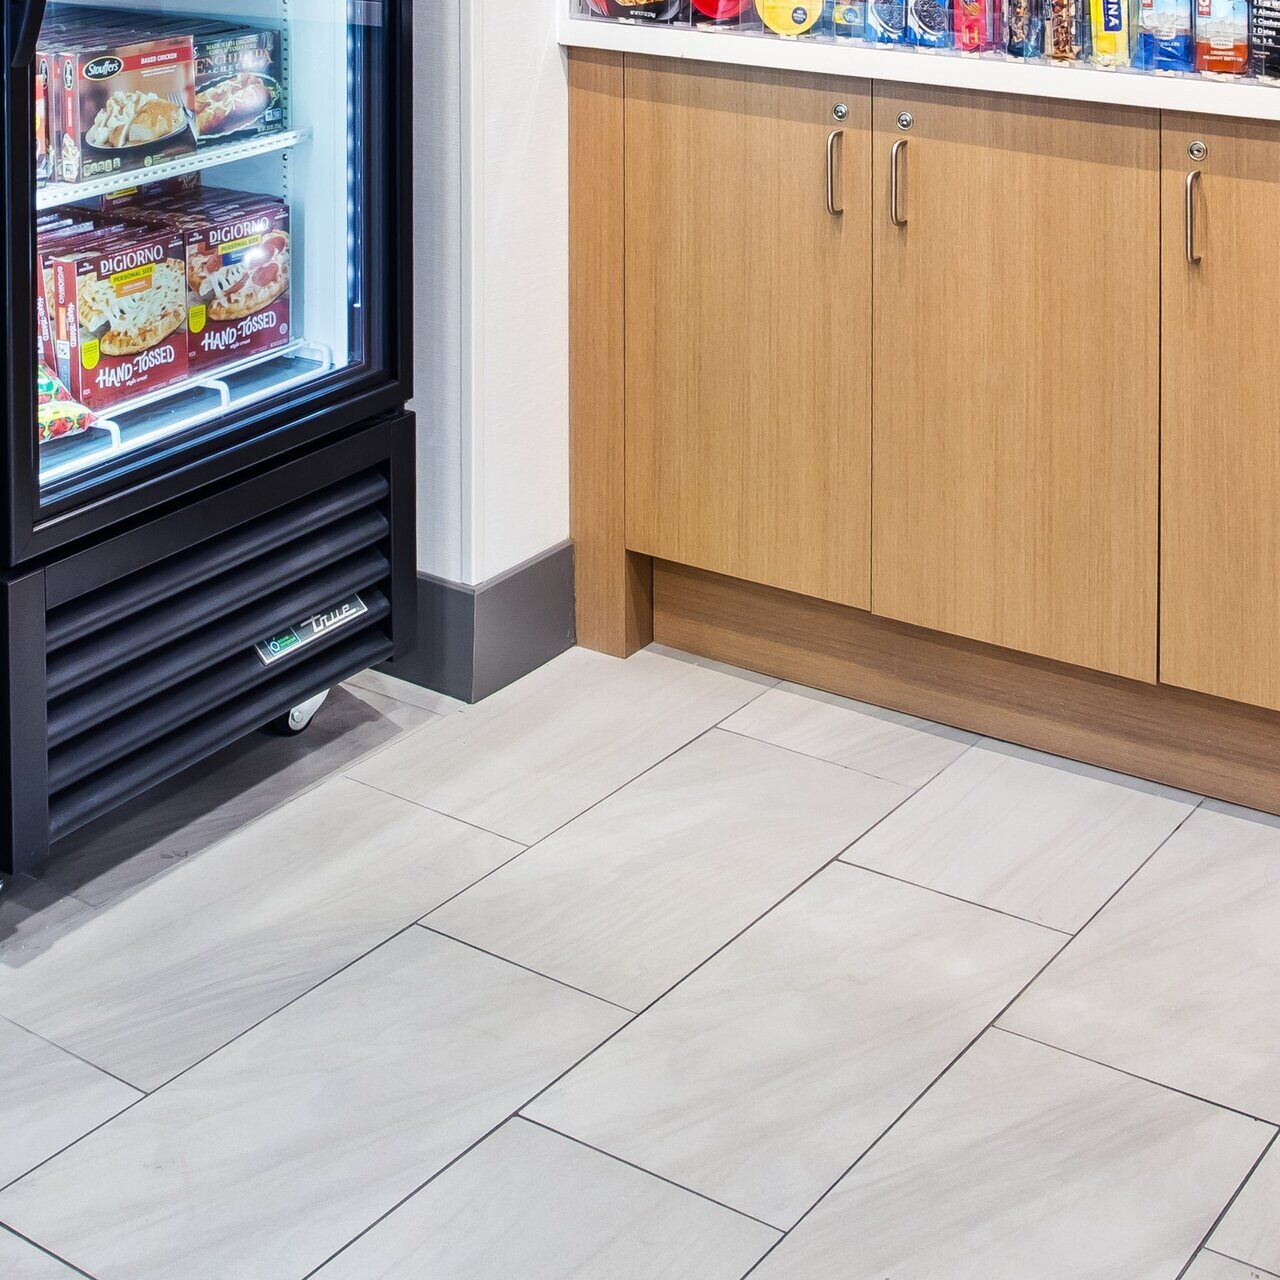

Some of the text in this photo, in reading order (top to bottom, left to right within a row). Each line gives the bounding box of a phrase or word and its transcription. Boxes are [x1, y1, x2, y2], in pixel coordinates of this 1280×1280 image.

[86, 60, 120, 78] Stouffer's
[220, 239, 247, 253] PERSONAL
[113, 267, 141, 284] PERSONAL
[201, 310, 277, 352] HAND-TOSSED
[95, 344, 175, 389] HAND-TOSSED
